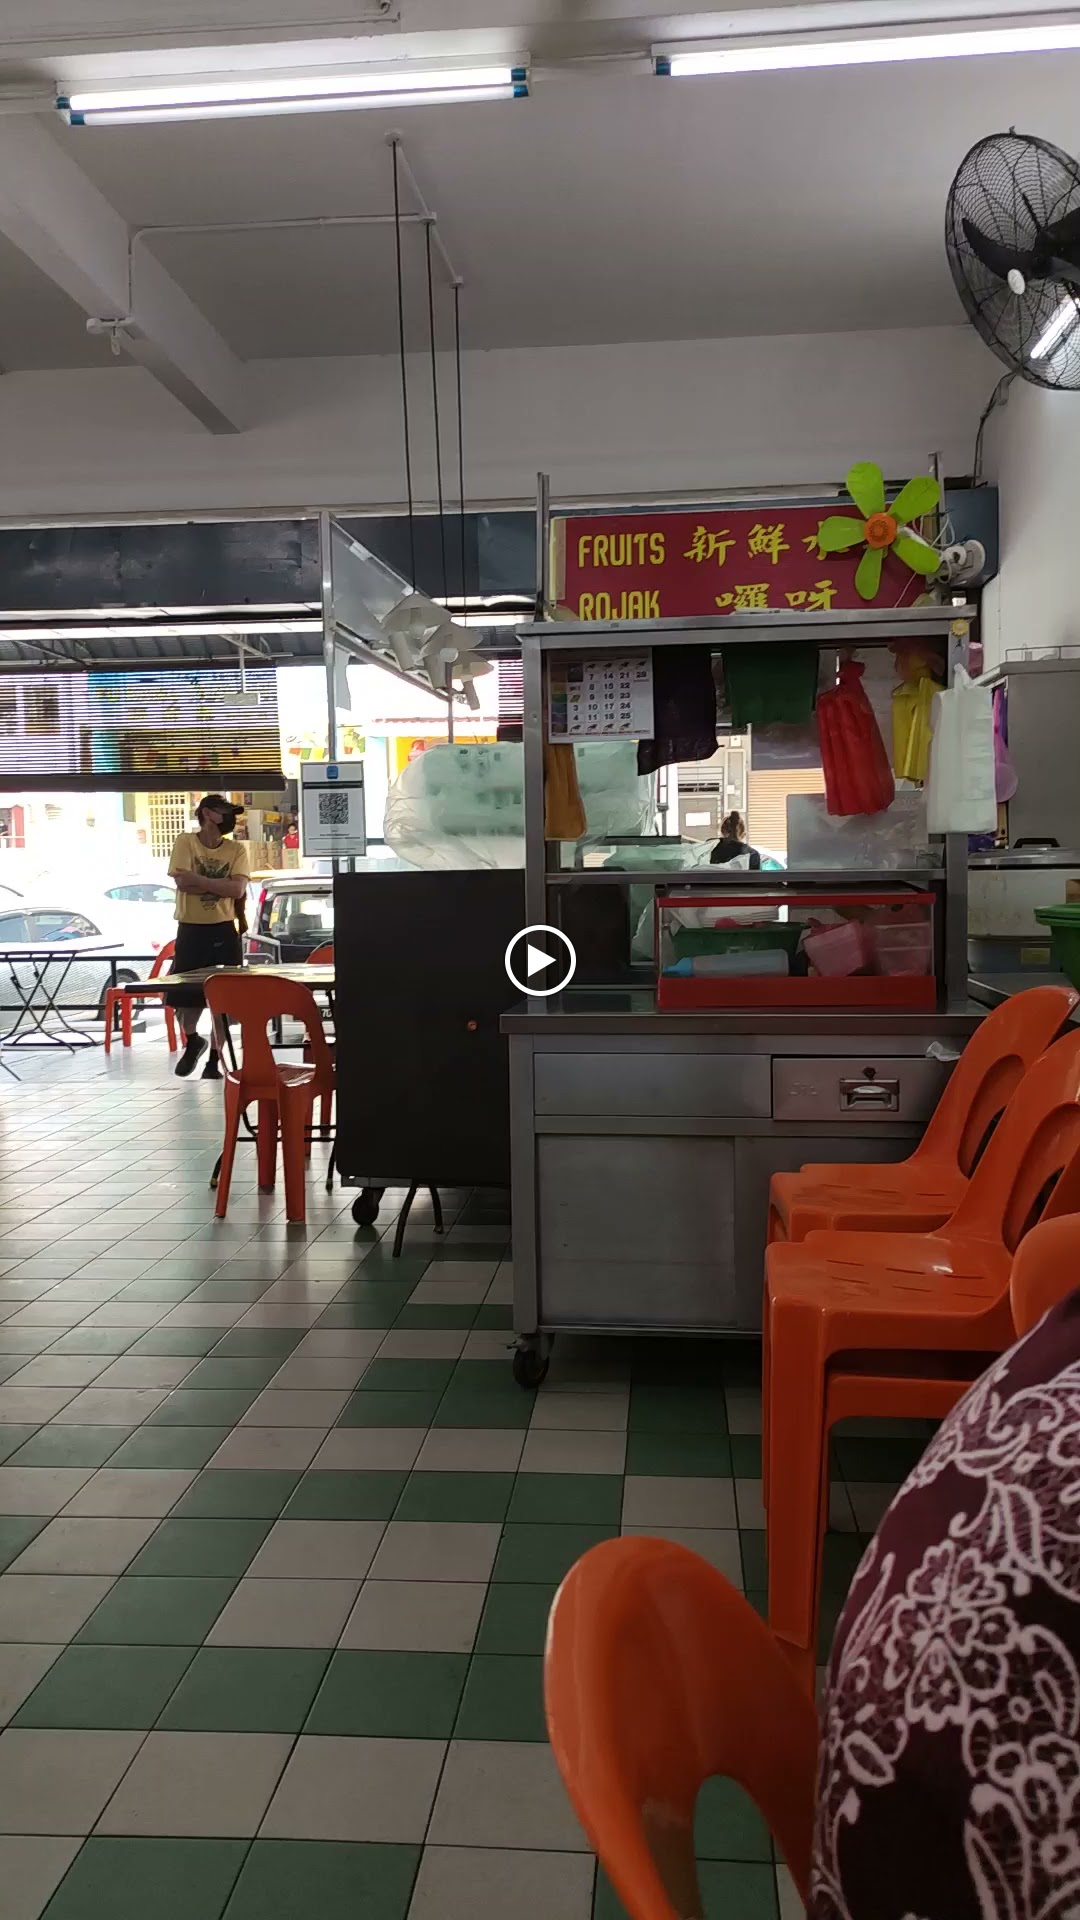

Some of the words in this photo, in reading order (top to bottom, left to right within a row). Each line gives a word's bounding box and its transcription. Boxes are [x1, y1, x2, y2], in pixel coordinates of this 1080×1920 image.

[578, 532, 666, 568] FRUITS
[683, 521, 888, 568] 新鮮
[578, 590, 661, 622] ROJAK
